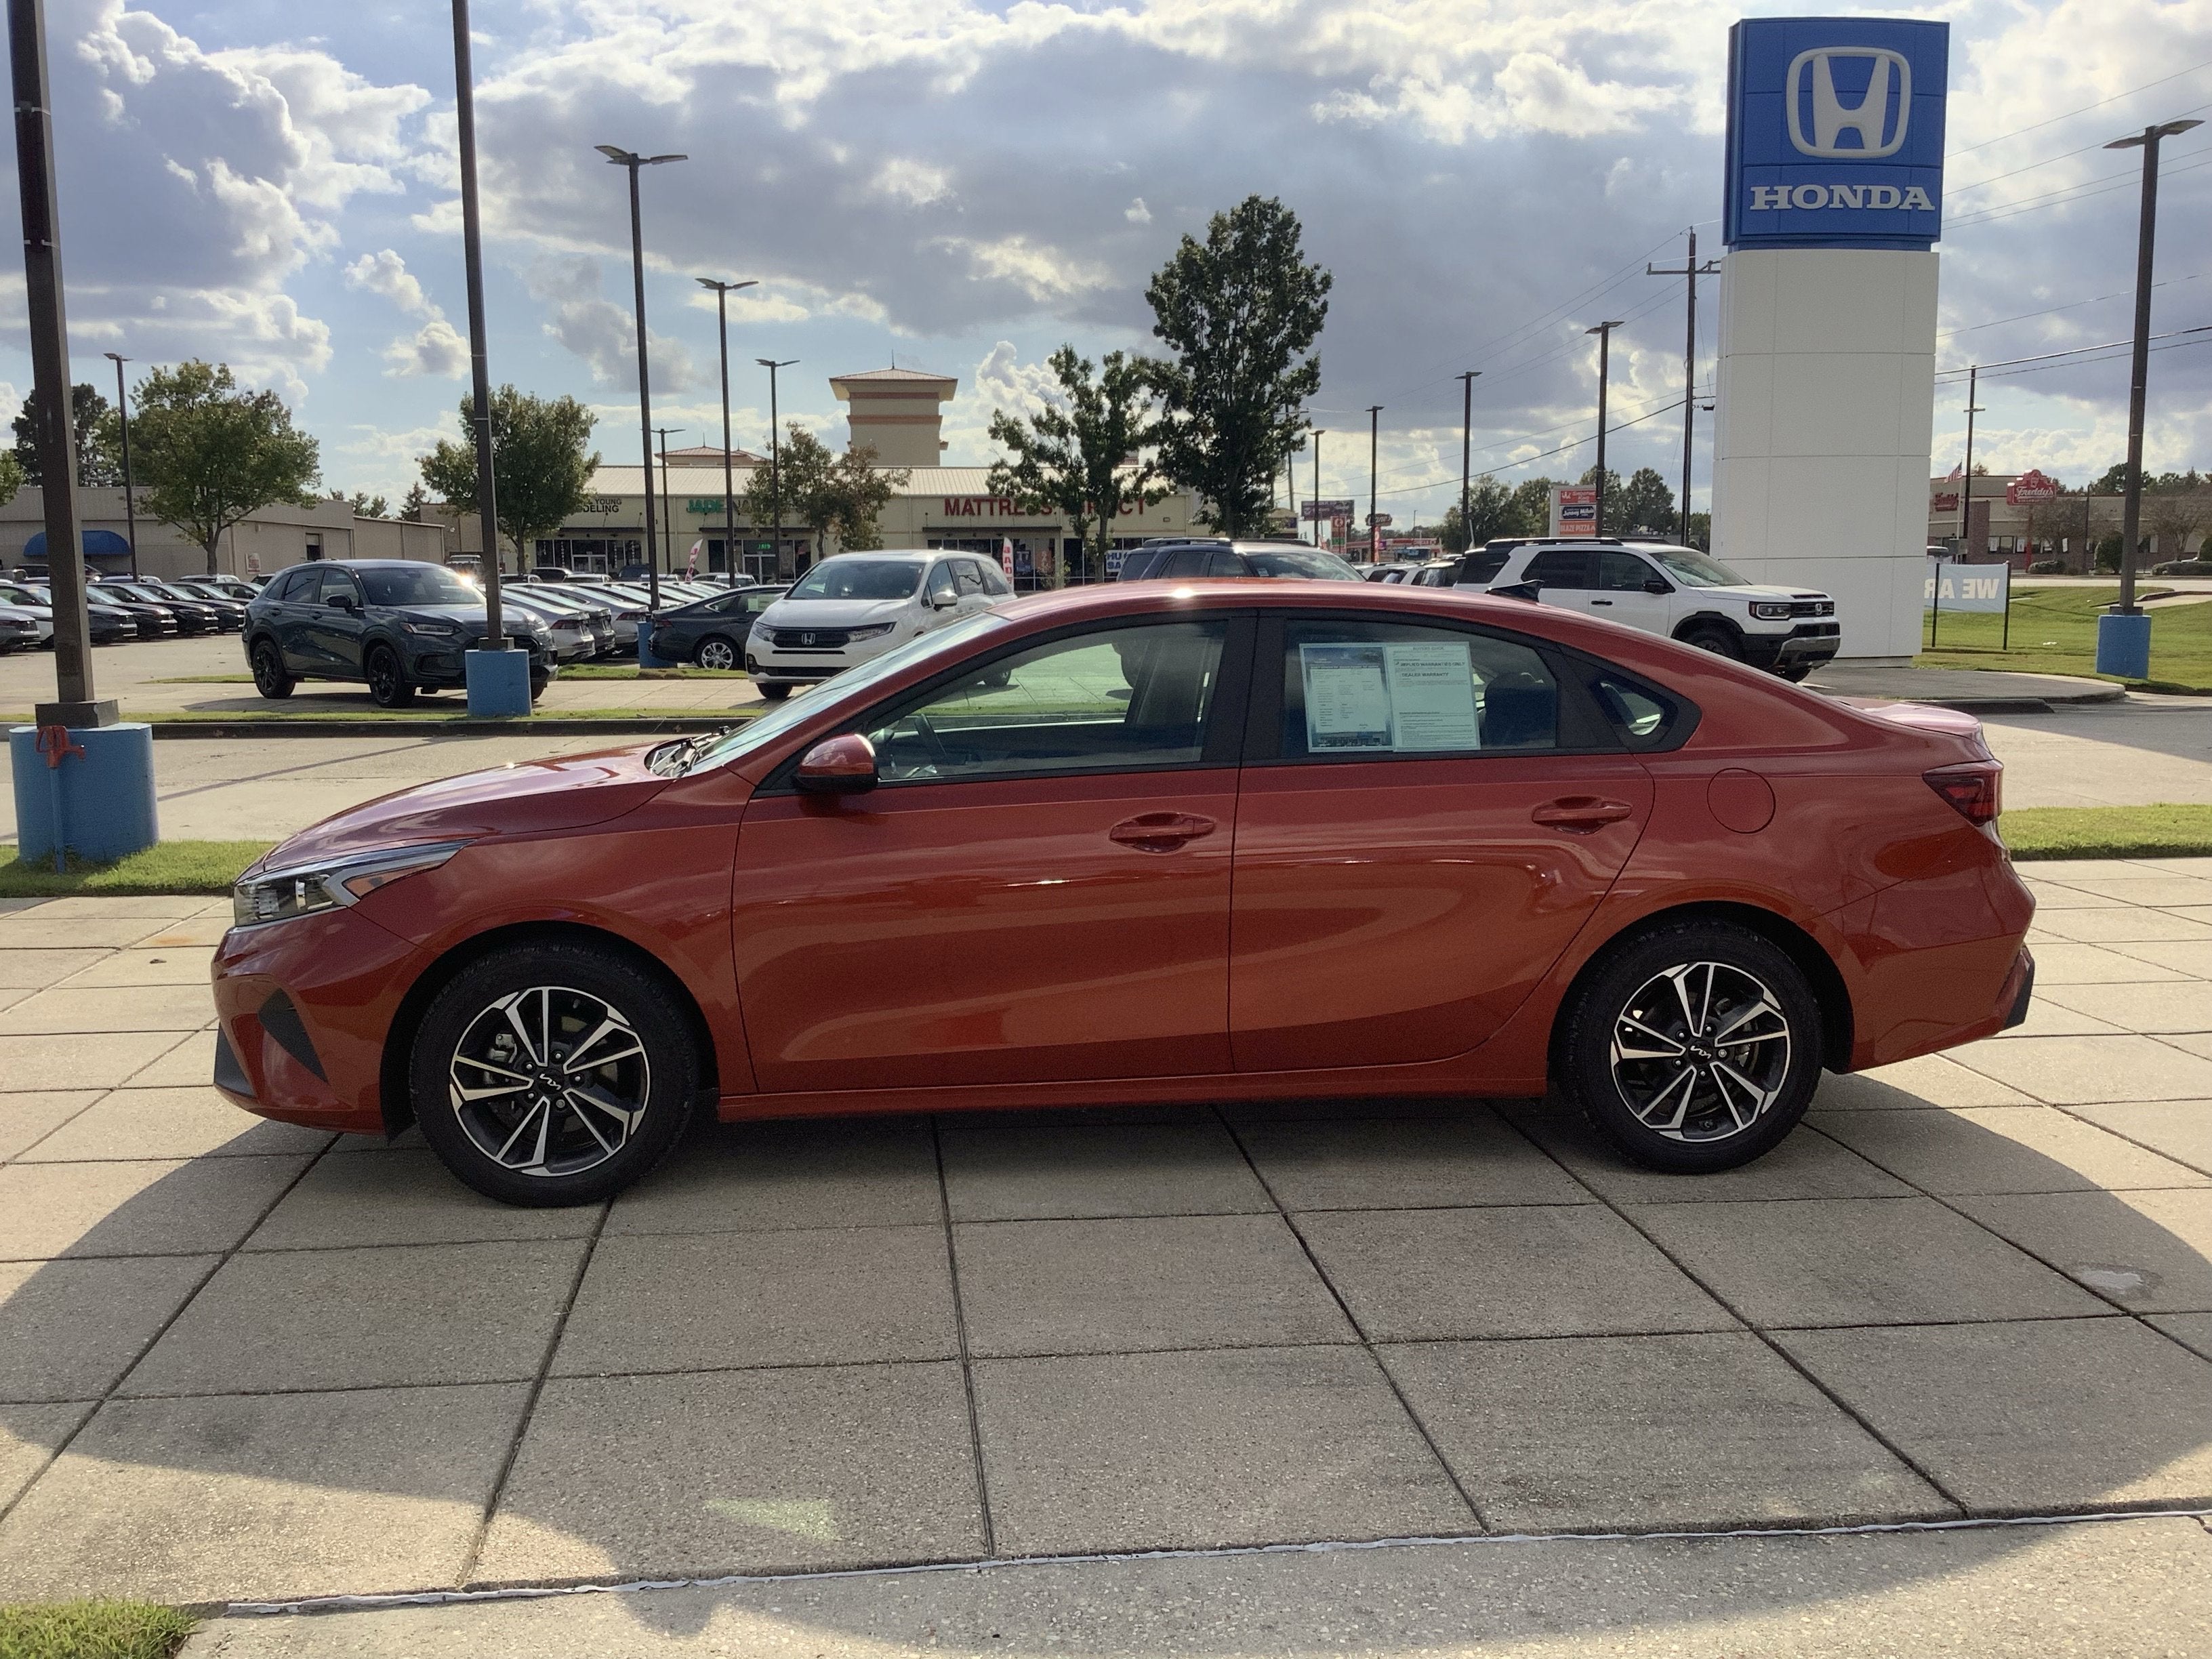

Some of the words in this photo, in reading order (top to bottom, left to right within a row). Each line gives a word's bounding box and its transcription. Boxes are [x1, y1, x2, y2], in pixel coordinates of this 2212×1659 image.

[1749, 184, 1936, 211] HONDA
[583, 505, 619, 513] DELING
[687, 499, 726, 514] JADE
[944, 498, 1053, 516] MATTRES
